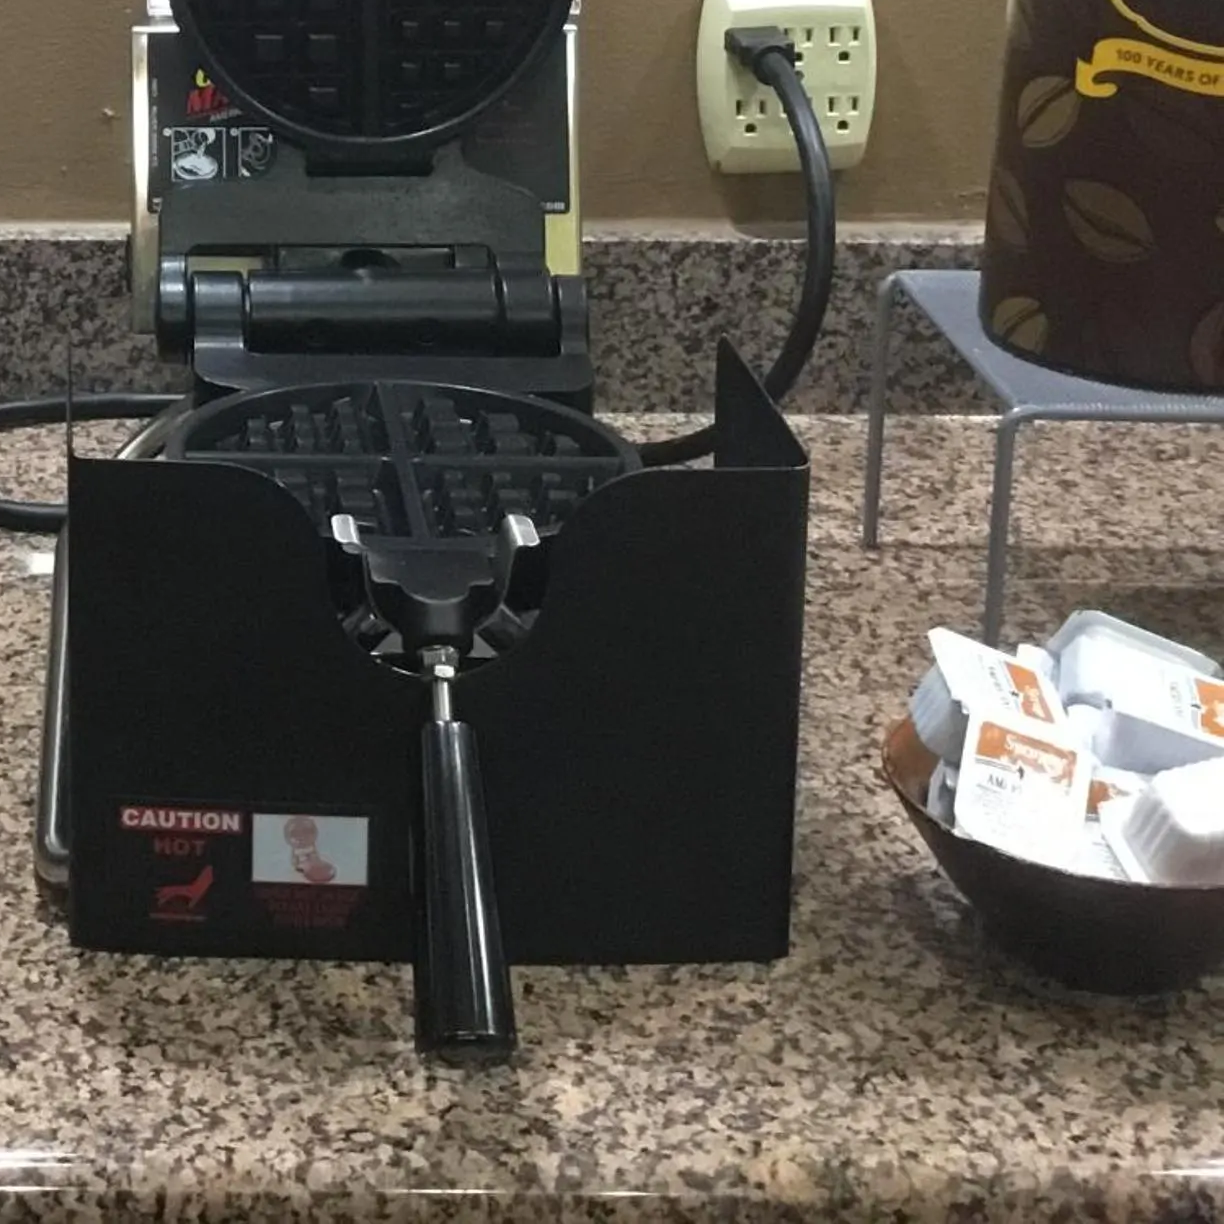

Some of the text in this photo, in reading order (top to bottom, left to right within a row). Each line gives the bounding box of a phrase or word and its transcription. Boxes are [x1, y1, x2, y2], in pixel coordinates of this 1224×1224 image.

[1115, 48, 1218, 87] 100 YEARS OF
[122, 808, 240, 832] CAUTION
[154, 837, 206, 855] HOT
